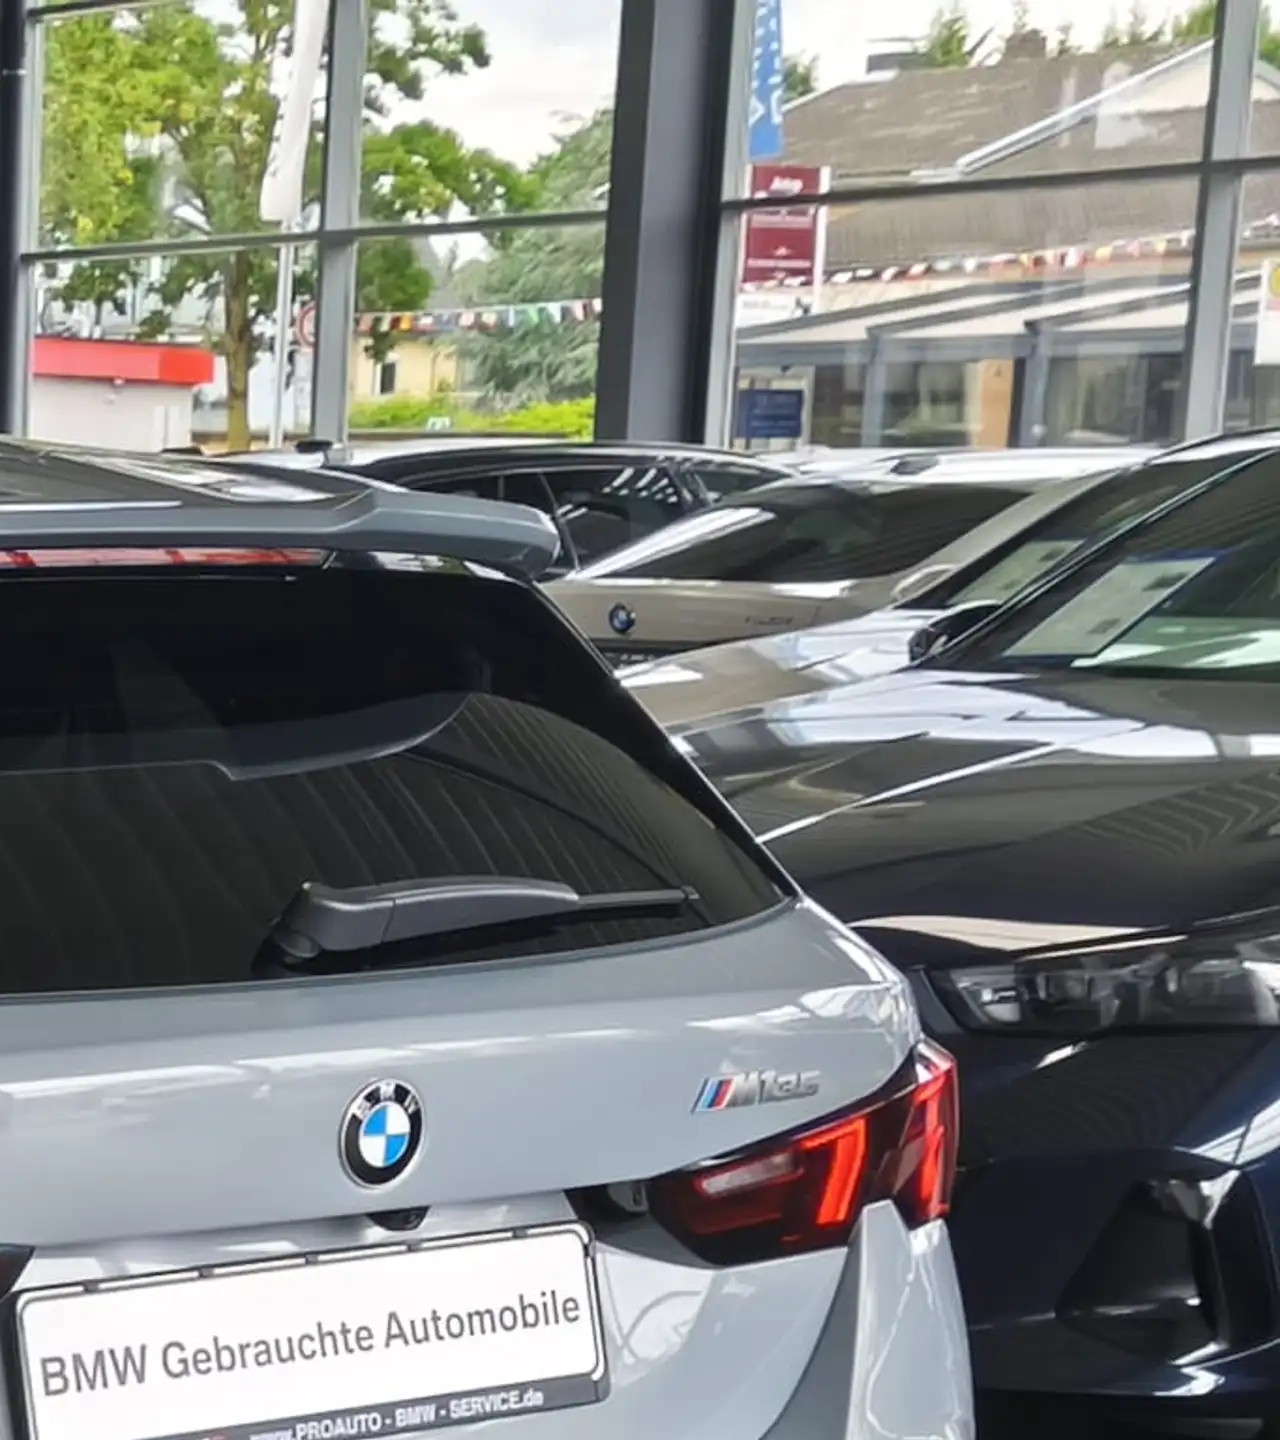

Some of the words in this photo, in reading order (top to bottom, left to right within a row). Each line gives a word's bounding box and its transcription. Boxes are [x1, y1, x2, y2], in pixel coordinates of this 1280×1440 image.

[351, 1081, 419, 1121] BMW
[40, 1343, 147, 1397] BMW
[161, 1320, 375, 1379] Gebrauchte
[384, 1289, 581, 1349] Automobile
